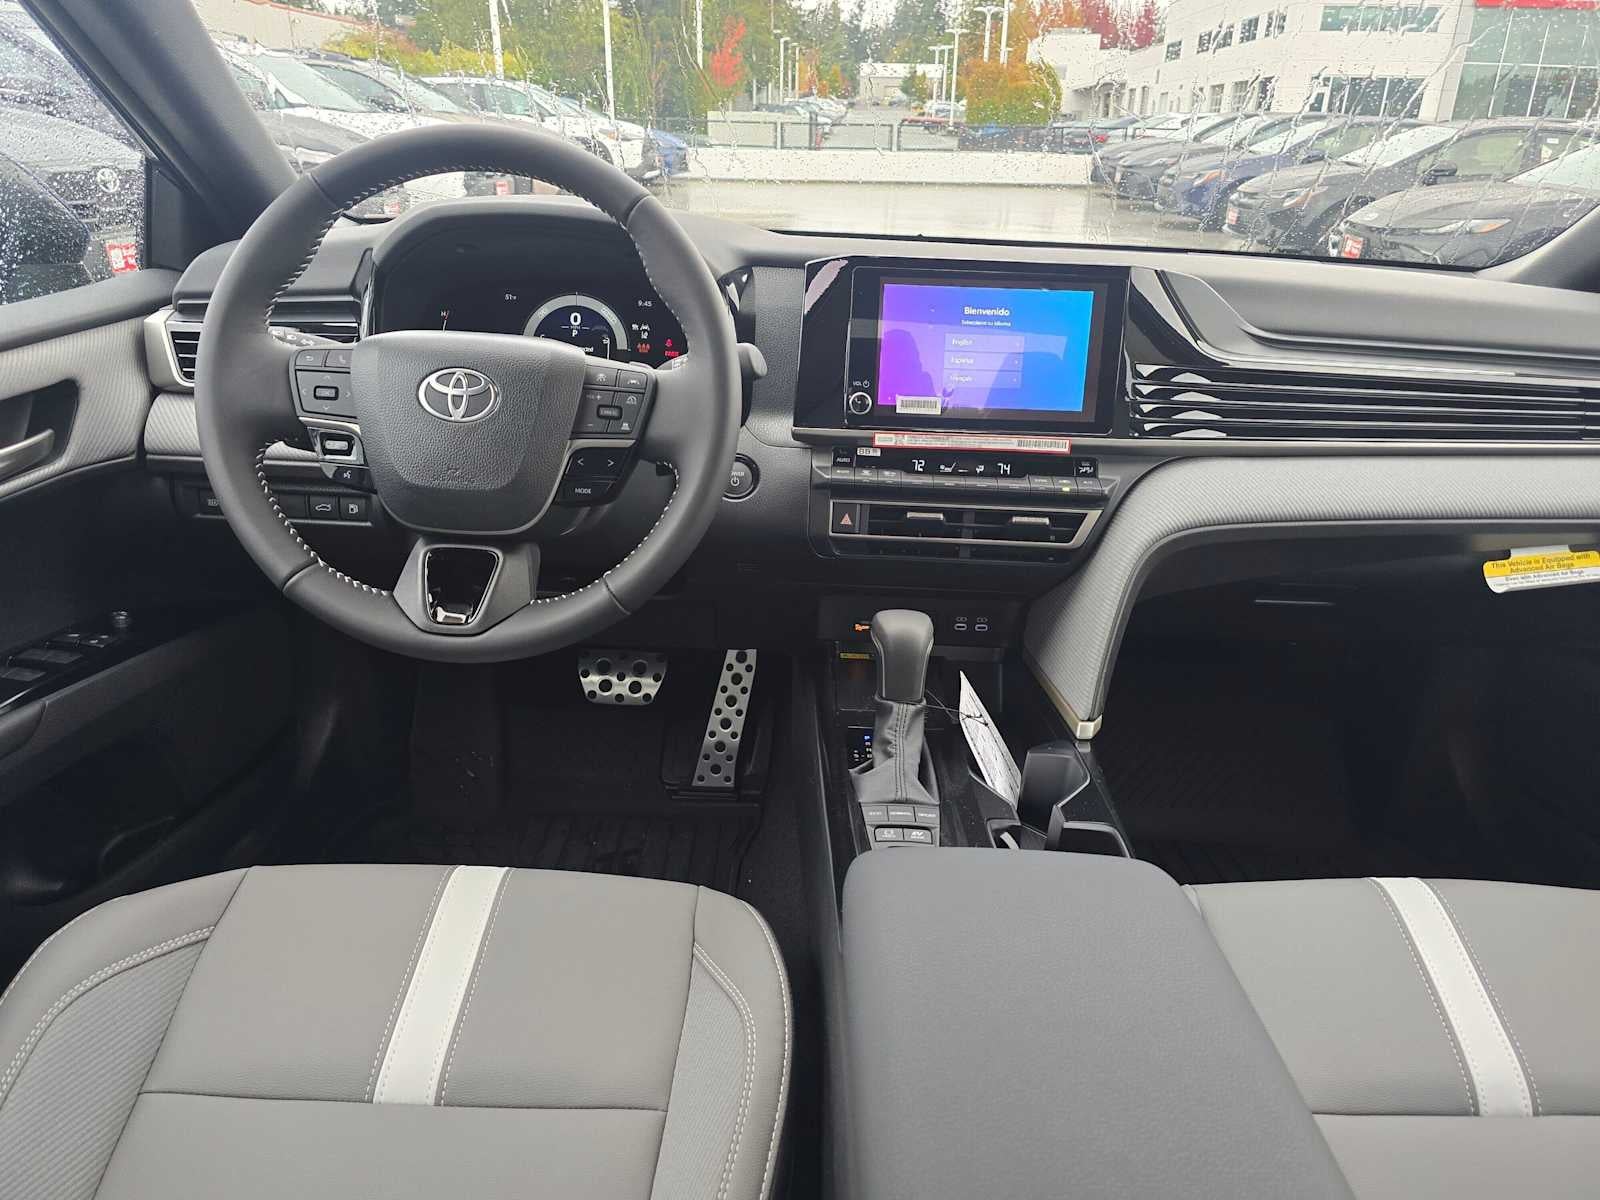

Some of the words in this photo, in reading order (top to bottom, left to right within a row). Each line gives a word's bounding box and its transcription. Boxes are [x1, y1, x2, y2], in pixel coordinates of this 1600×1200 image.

[964, 306, 1010, 316] Bienvenido
[570, 312, 581, 326] 0
[572, 329, 578, 337] P
[912, 460, 925, 472] 72
[997, 463, 1011, 475] 74
[1508, 558, 1532, 567] Vehicle
[1542, 554, 1574, 565] Equipped
